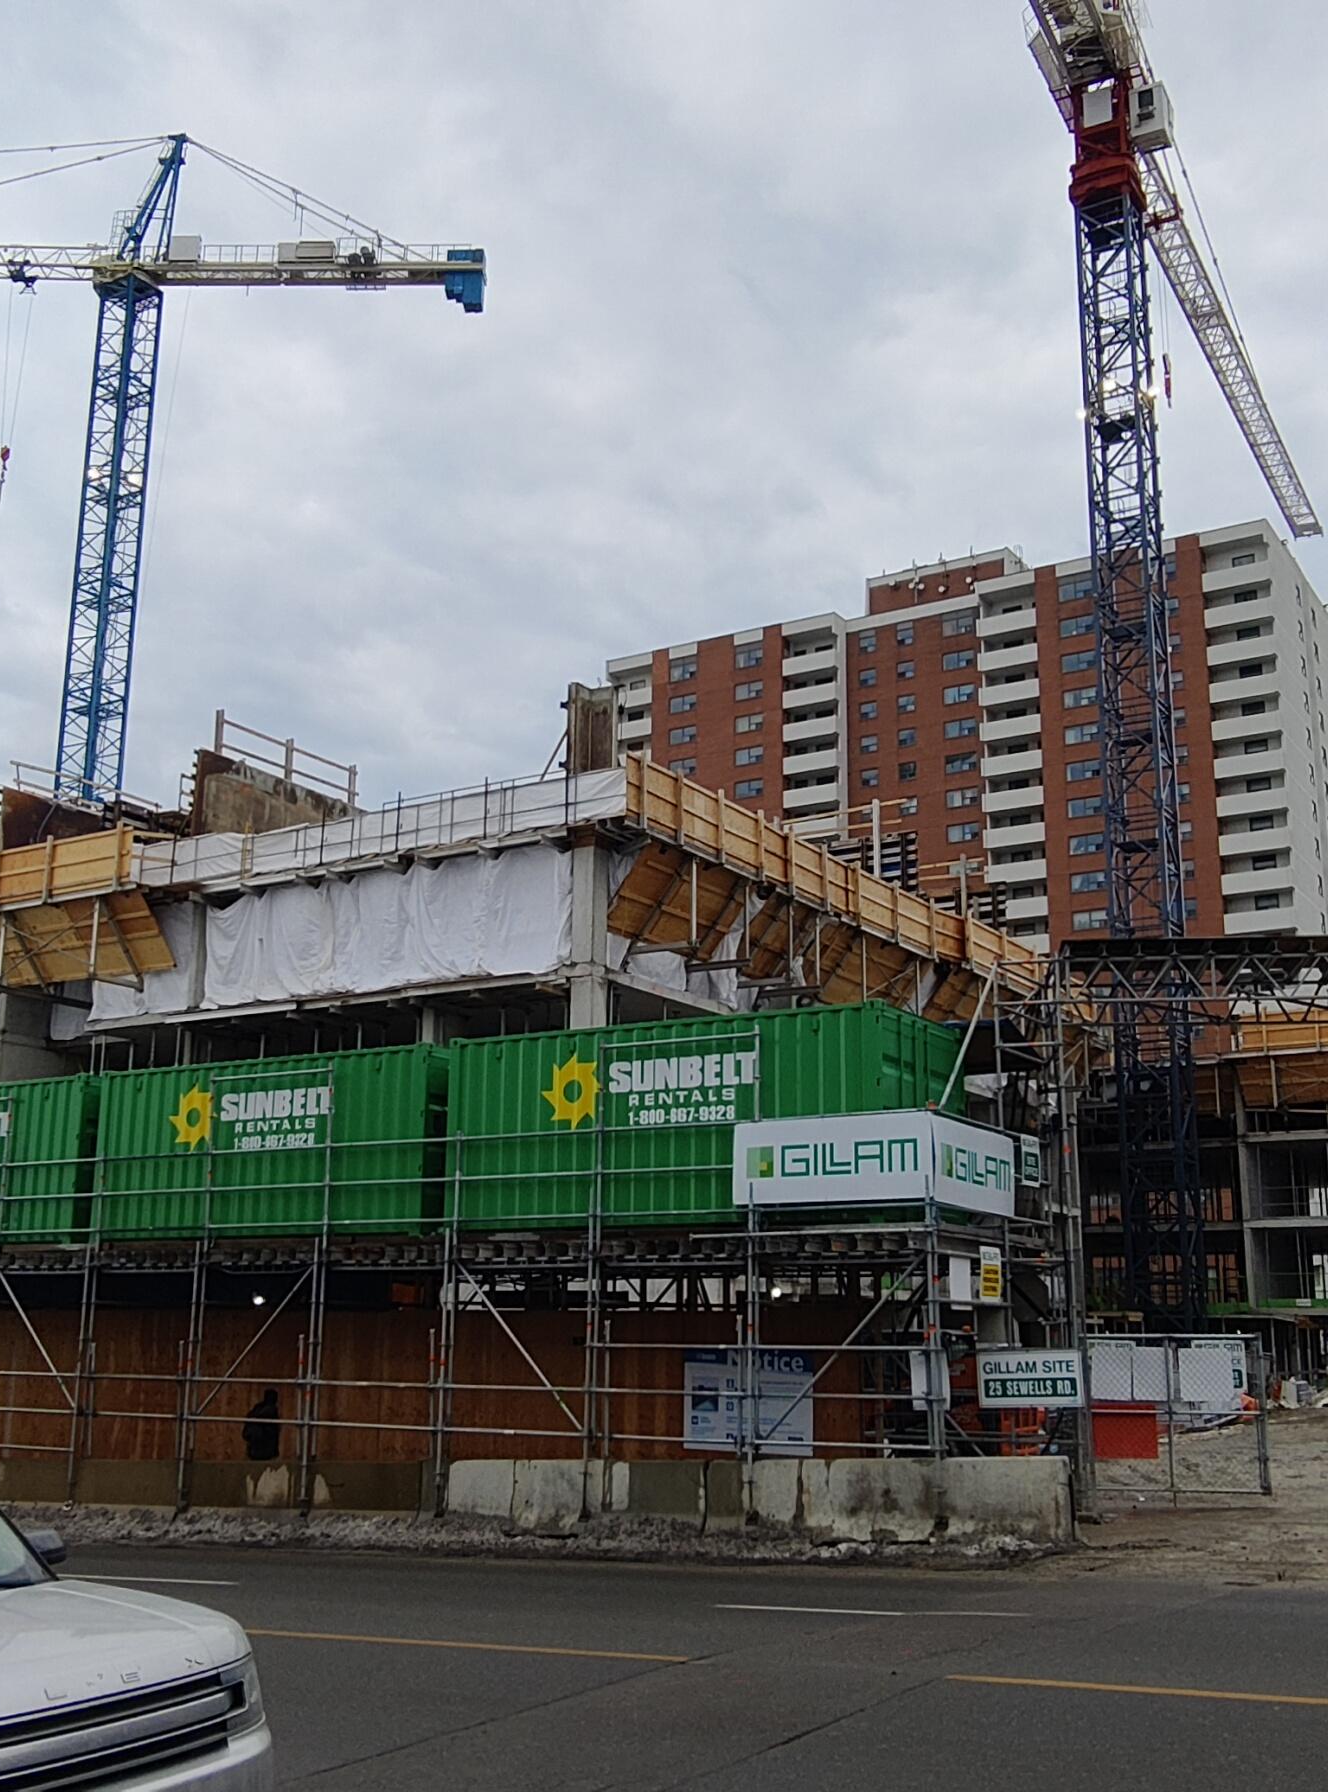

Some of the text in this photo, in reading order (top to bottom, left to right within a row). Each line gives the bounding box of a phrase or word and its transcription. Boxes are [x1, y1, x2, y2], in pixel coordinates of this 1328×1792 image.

[608, 1051, 756, 1093] SUNBELT
[220, 1086, 333, 1121] SUNBELT
[628, 1088, 735, 1107] RENTALS
[628, 1105, 735, 1125] 1-800-667-9328
[234, 1118, 315, 1133] RENTALS
[780, 1137, 918, 1178] GILLAM
[954, 1147, 1011, 1193] GILLAM
[982, 1359, 1075, 1375] GILLAM SITE
[989, 1379, 1075, 1396] 25 SEWELLS RD.
